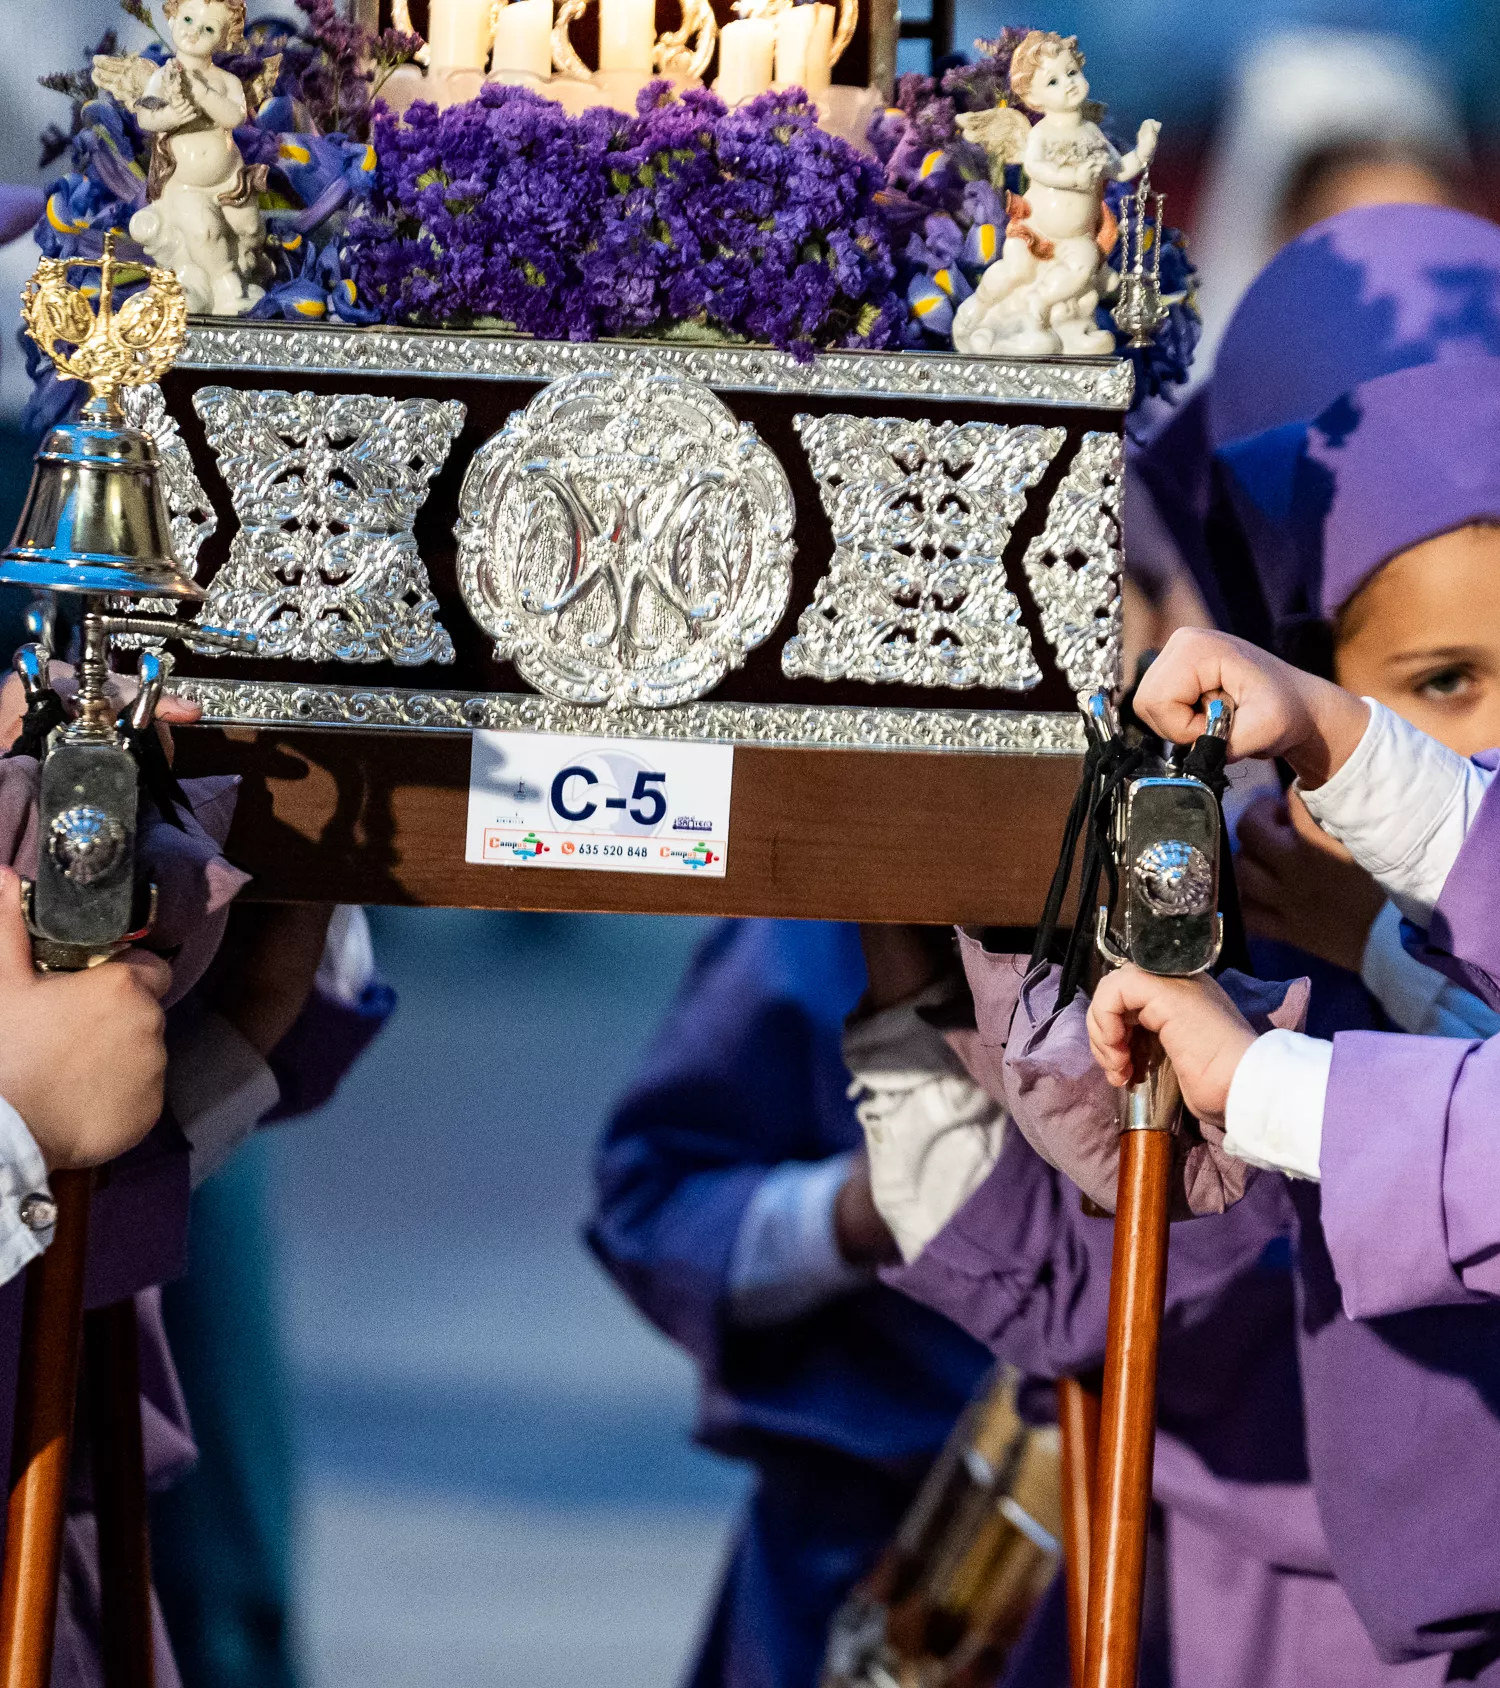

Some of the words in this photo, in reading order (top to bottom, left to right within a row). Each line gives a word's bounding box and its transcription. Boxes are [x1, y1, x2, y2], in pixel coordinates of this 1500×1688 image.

[551, 766, 667, 825] C-5
[578, 843, 599, 855] 635
[603, 844, 623, 857] 520
[627, 846, 648, 857] 848
